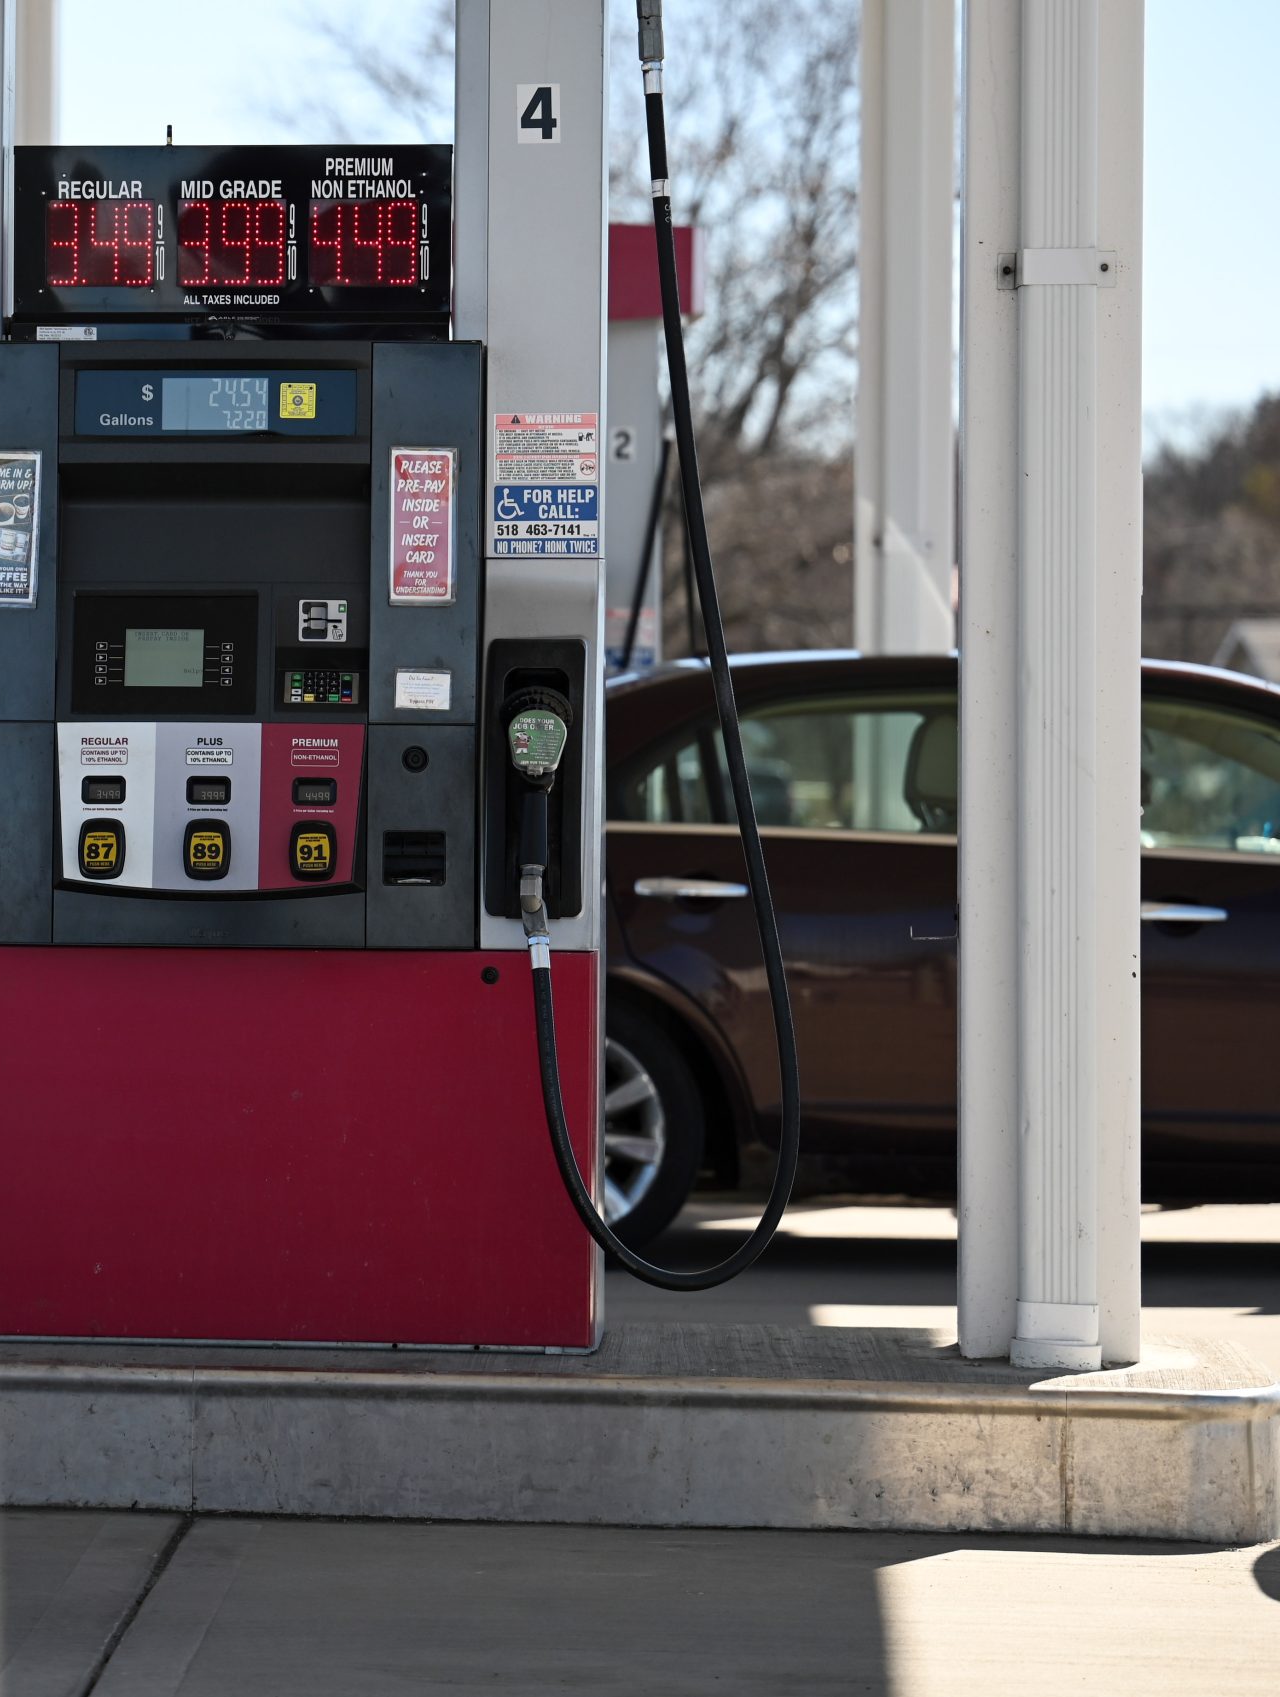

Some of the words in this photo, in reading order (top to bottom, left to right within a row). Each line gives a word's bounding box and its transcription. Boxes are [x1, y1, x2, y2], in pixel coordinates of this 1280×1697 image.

[521, 87, 557, 139] 4
[325, 157, 393, 177] PREMIUM
[58, 181, 142, 199] REGULAR
[181, 180, 213, 198] MID
[219, 180, 282, 198] GRADE
[311, 180, 344, 198] NON
[348, 180, 415, 198] ETHANOL
[157, 204, 164, 238] 9
[288, 204, 295, 238] 9
[422, 204, 428, 238] 9
[49, 203, 152, 285] 3.49
[181, 203, 283, 285] 3.99
[313, 203, 415, 285] 4.49
[156, 246, 165, 281] 10
[287, 246, 297, 281] 10
[420, 246, 429, 281] 10
[183, 295, 200, 305] ALL
[202, 295, 231, 305] TAXES
[234, 295, 280, 305] INCLUDED
[141, 383, 154, 401] $
[209, 378, 267, 407] 24.54
[99, 413, 154, 426] Gallons
[222, 411, 266, 429] 7.220
[525, 414, 582, 423] WARNING
[614, 431, 631, 459] 2
[13, 468, 22, 478] IN
[24, 469, 32, 478] &
[401, 461, 443, 474] PLEASE
[16, 480, 33, 490] UP!
[397, 479, 445, 493] PRE-PAY
[523, 489, 552, 503] FOR
[557, 489, 595, 503] HELP
[402, 499, 440, 512] INSIDE
[538, 505, 579, 519] CALL:
[413, 516, 429, 529] OR
[497, 524, 519, 536] 518
[526, 524, 580, 536] 463-7141
[401, 534, 439, 547] INSERT
[497, 541, 509, 553] NO
[511, 541, 542, 553] PHONE?
[545, 541, 568, 553] HONK
[570, 541, 595, 553] TWICE
[406, 551, 435, 563] CARD
[403, 570, 424, 578] THANK
[396, 586, 446, 594] UNDERSTANDING
[81, 737, 128, 745] REGULAR
[197, 737, 223, 745] PLUS
[292, 738, 338, 747] PREMIUM
[86, 843, 114, 859] 87
[193, 843, 220, 860] 89
[299, 844, 327, 860] 91
